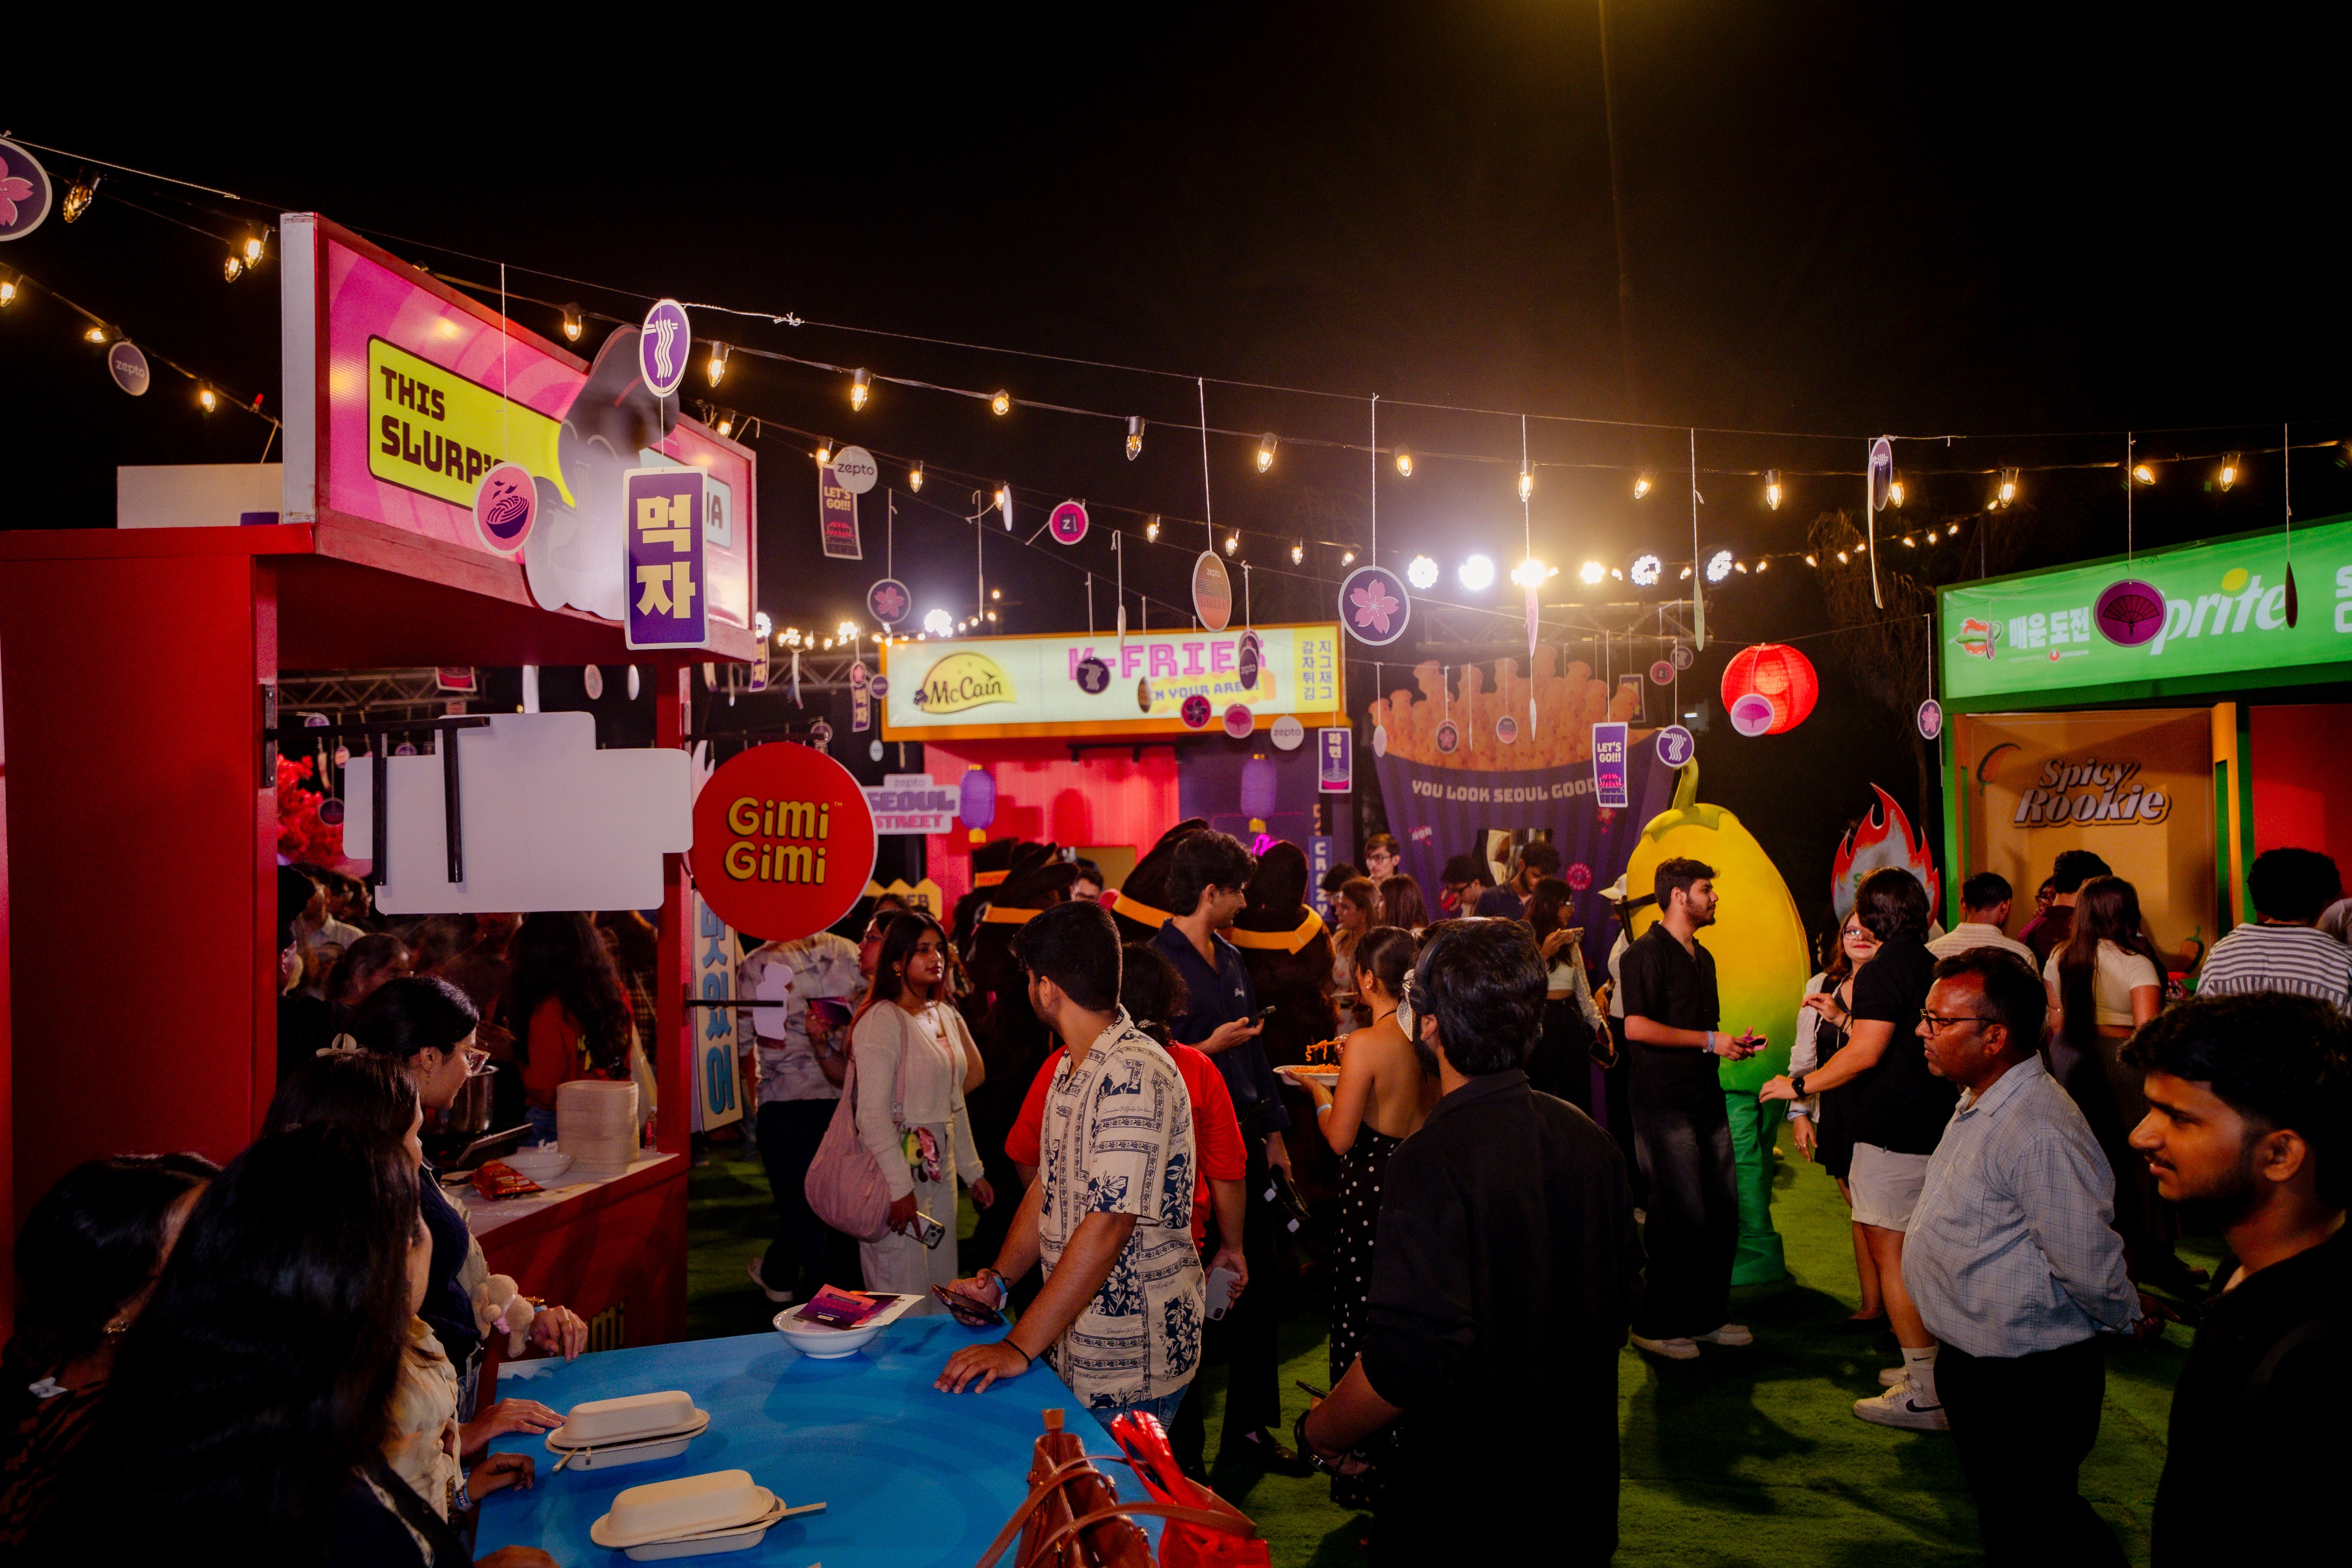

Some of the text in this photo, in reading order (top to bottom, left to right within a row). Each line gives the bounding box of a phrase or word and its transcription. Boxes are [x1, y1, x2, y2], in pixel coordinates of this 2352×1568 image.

[115, 359, 145, 377] zepto
[380, 365, 445, 422] THIS
[382, 414, 506, 484] SLURP'
[837, 463, 874, 476] zepto
[824, 486, 851, 500] LET'S
[826, 498, 851, 511] GO!!!
[636, 494, 696, 619] 먹자
[1207, 568, 1221, 579] zepto
[1197, 579, 1230, 599] SEOUL
[2150, 569, 2287, 656] prite
[2009, 606, 2090, 649] 매운 도전
[1068, 640, 1266, 681] K-FRIE
[2060, 649, 2089, 658] NONGSHIM
[930, 677, 1003, 704] McCain
[1151, 680, 1259, 701] N YOUR ARE!
[1274, 728, 1301, 738] zepto
[1597, 741, 1622, 753] LET'S
[1599, 752, 1621, 763] GO!!!
[894, 778, 926, 788] zepto
[2039, 758, 2140, 794] Spicy
[867, 791, 956, 811] SEOUL
[1412, 779, 1444, 798] YOU
[1446, 785, 1491, 803] LOOK
[1494, 785, 1549, 803] SEOUL
[2013, 784, 2169, 824] Rookie
[727, 797, 830, 840] Gimi
[874, 814, 943, 828] STREET
[723, 841, 826, 884] Gimi
